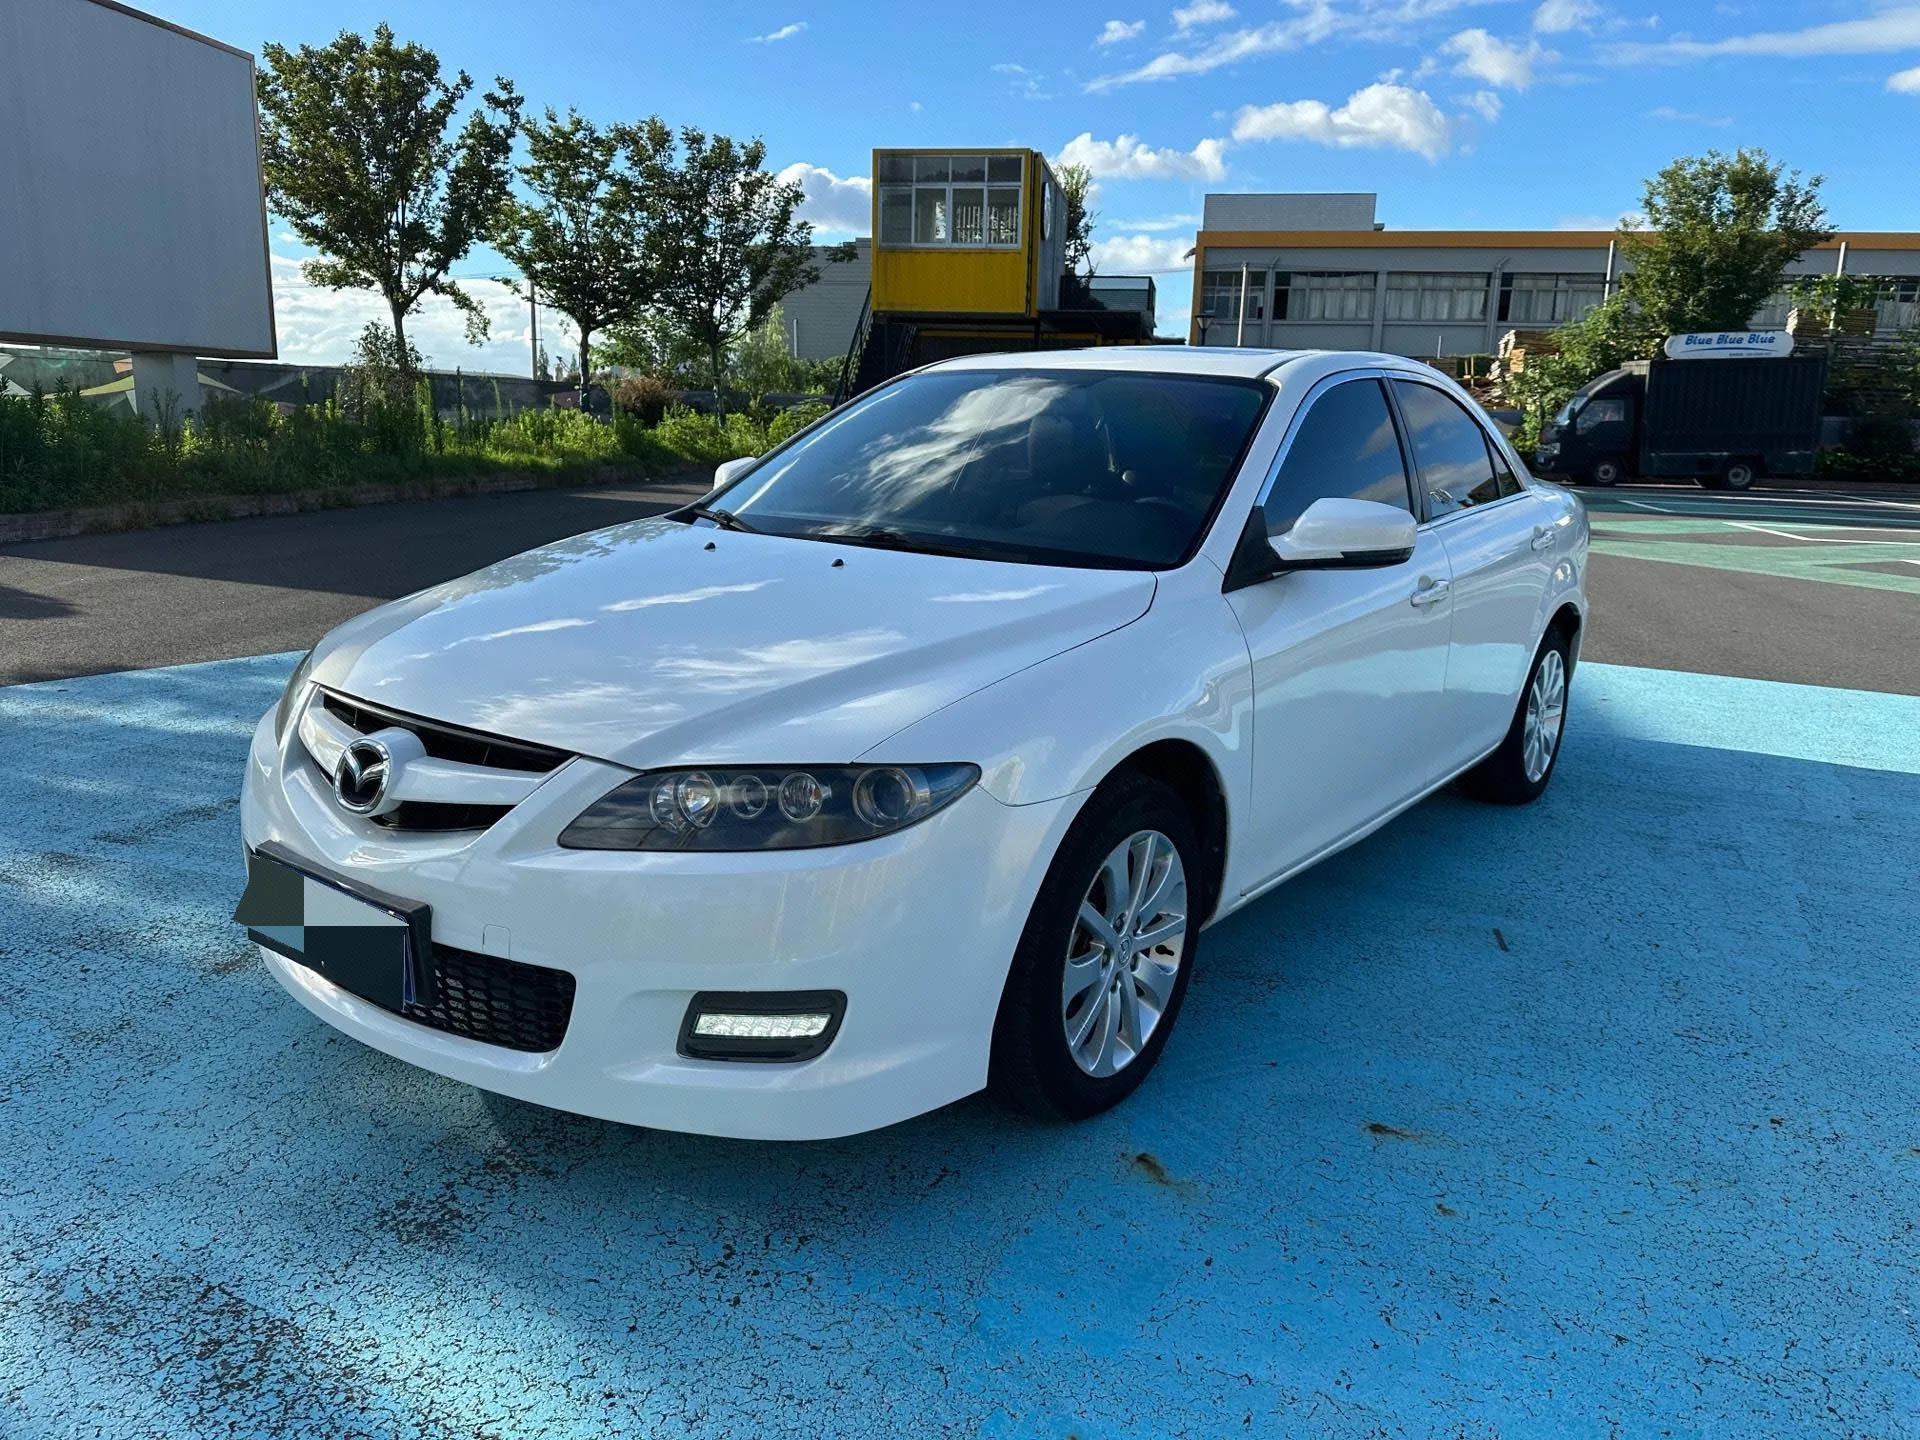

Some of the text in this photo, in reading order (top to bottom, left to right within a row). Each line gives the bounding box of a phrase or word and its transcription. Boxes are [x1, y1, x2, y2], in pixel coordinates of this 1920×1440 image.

[1685, 333, 1776, 345] Blue Blue Blue
